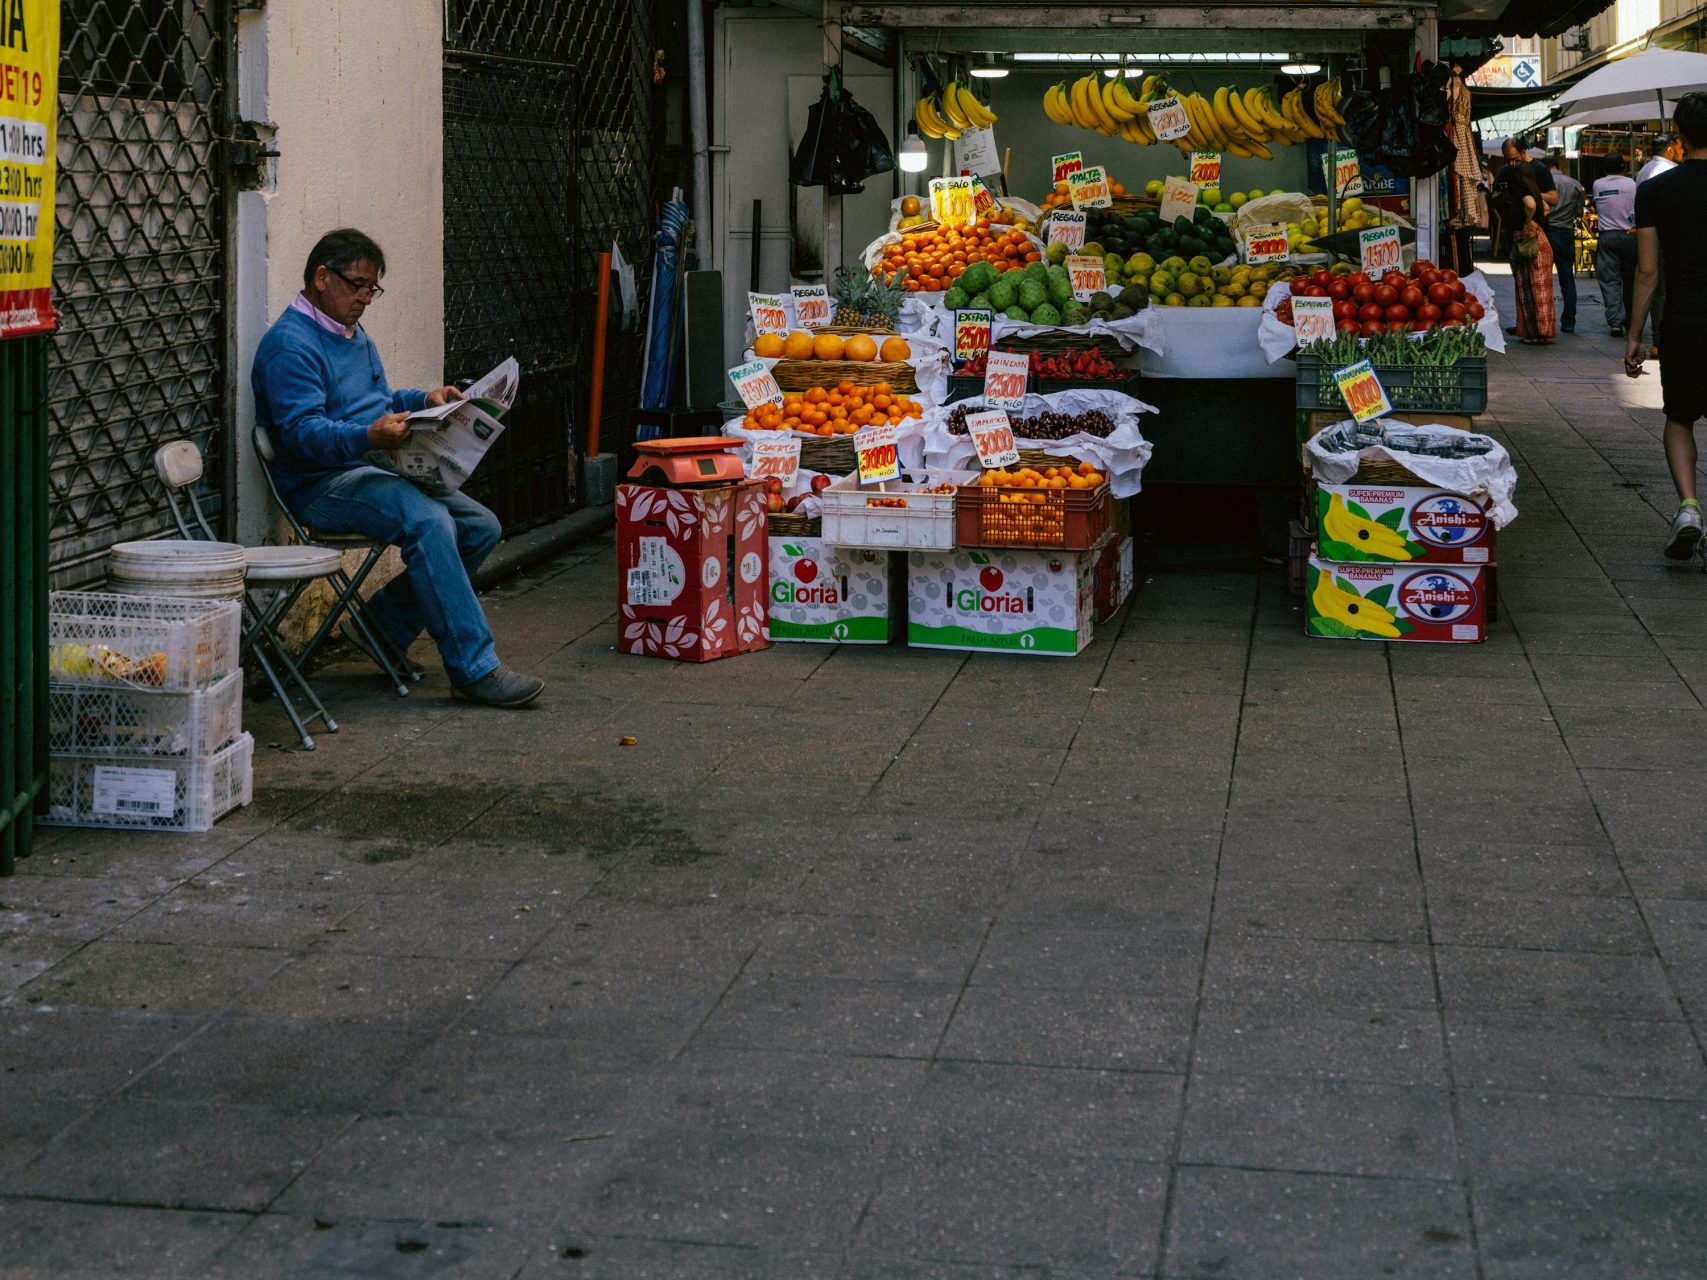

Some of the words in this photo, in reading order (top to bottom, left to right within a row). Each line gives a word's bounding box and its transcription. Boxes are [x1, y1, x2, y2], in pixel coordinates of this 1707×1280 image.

[1324, 151, 1356, 164] RGALO
[1362, 179, 1394, 190] ARIBE
[1052, 212, 1084, 222] REGALO
[1361, 228, 1395, 242] REGALO
[793, 288, 825, 297] REGALO
[958, 313, 989, 323] EXTRA
[1345, 375, 1382, 414] 1000
[975, 428, 1013, 458] 3000
[1349, 489, 1370, 498] SUPER
[1371, 490, 1405, 499] PREMIUM
[1416, 513, 1466, 526] Anishi
[1338, 566, 1359, 575] SUPER
[1360, 567, 1394, 575] PREMIUM
[1349, 573, 1382, 581] BANANAS
[771, 582, 838, 604] Gloria
[1405, 590, 1455, 603] Anishi
[956, 589, 1024, 614] Gloria
